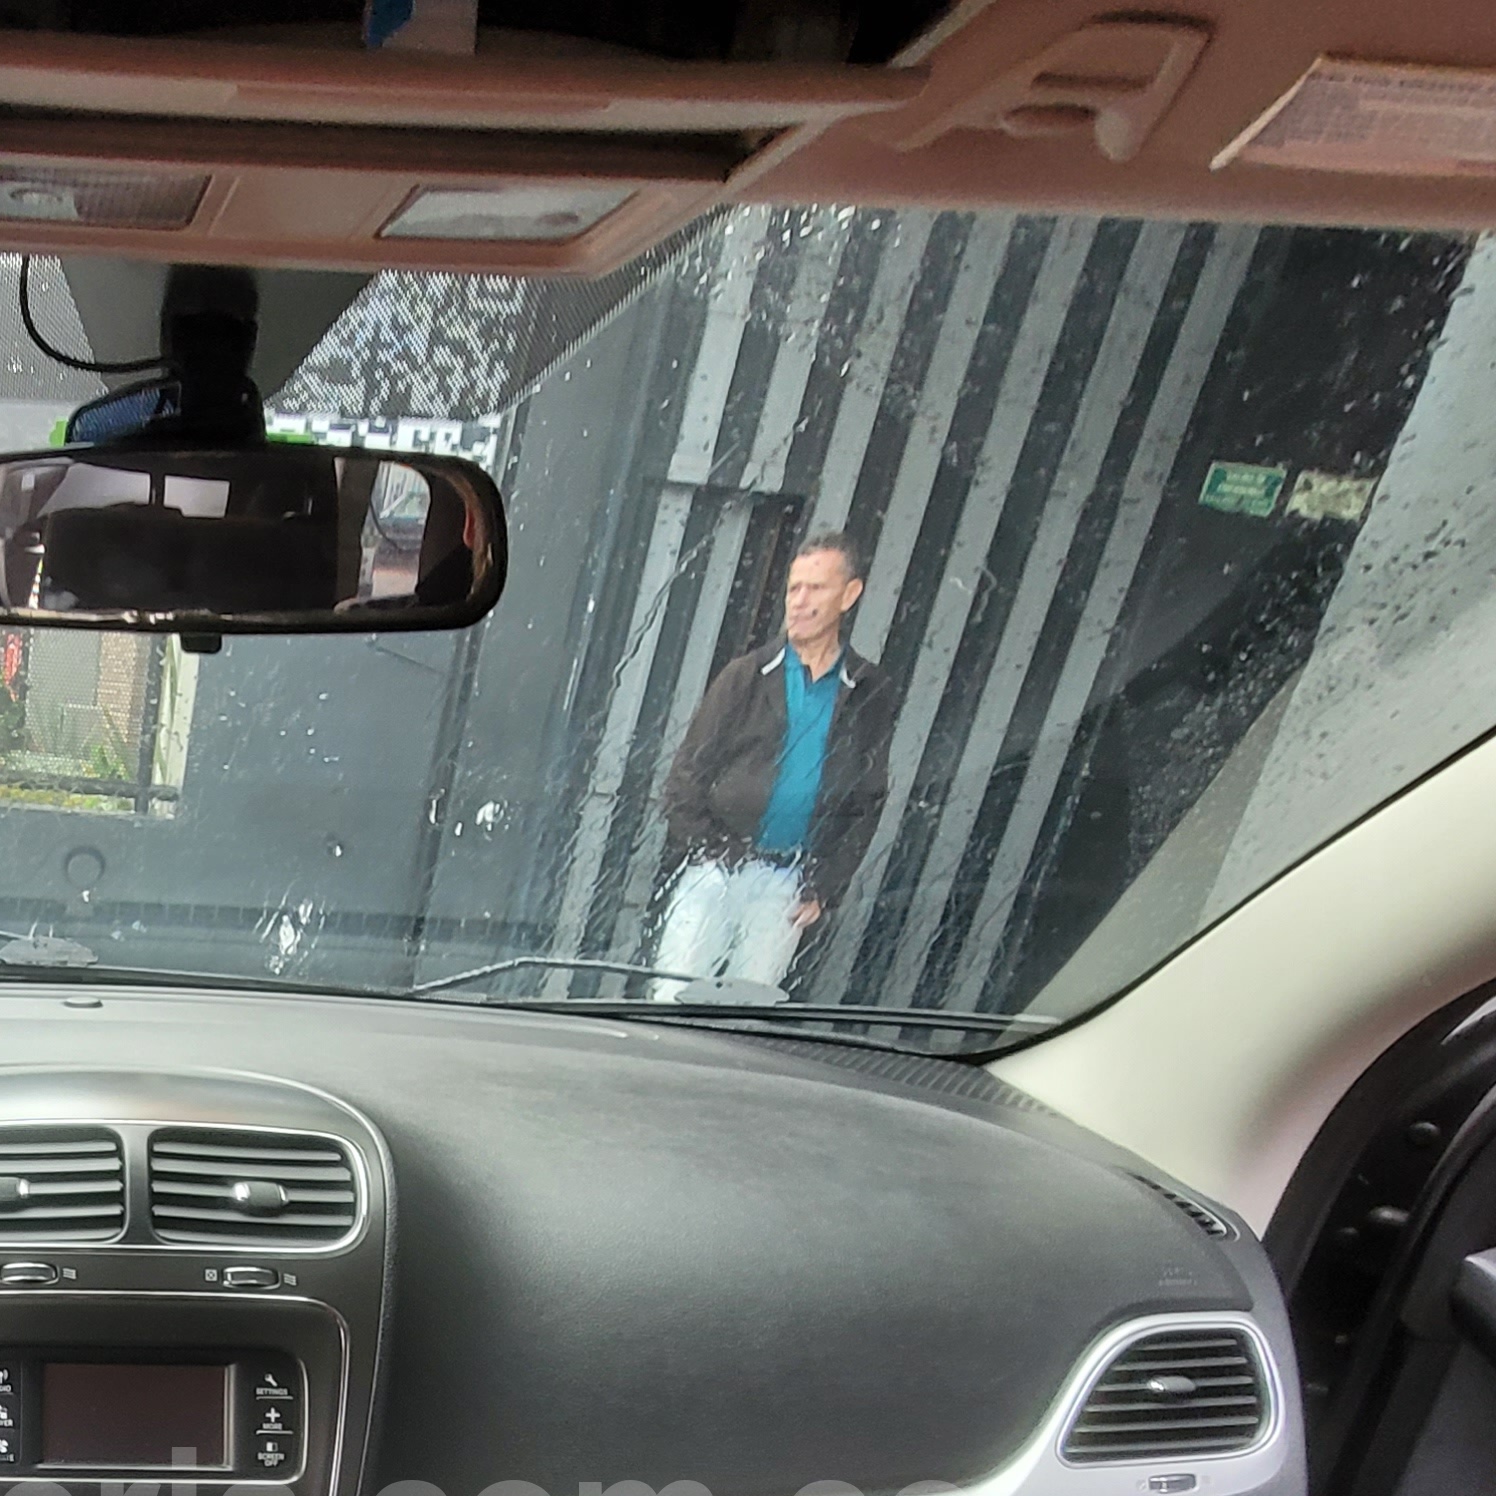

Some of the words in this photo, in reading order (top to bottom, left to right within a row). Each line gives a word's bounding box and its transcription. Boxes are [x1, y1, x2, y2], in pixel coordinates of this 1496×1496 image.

[256, 1387, 288, 1396] SETTINGS
[262, 1423, 283, 1431] MORE
[257, 1452, 285, 1461] SCREEN
[264, 1459, 278, 1467] OFF
